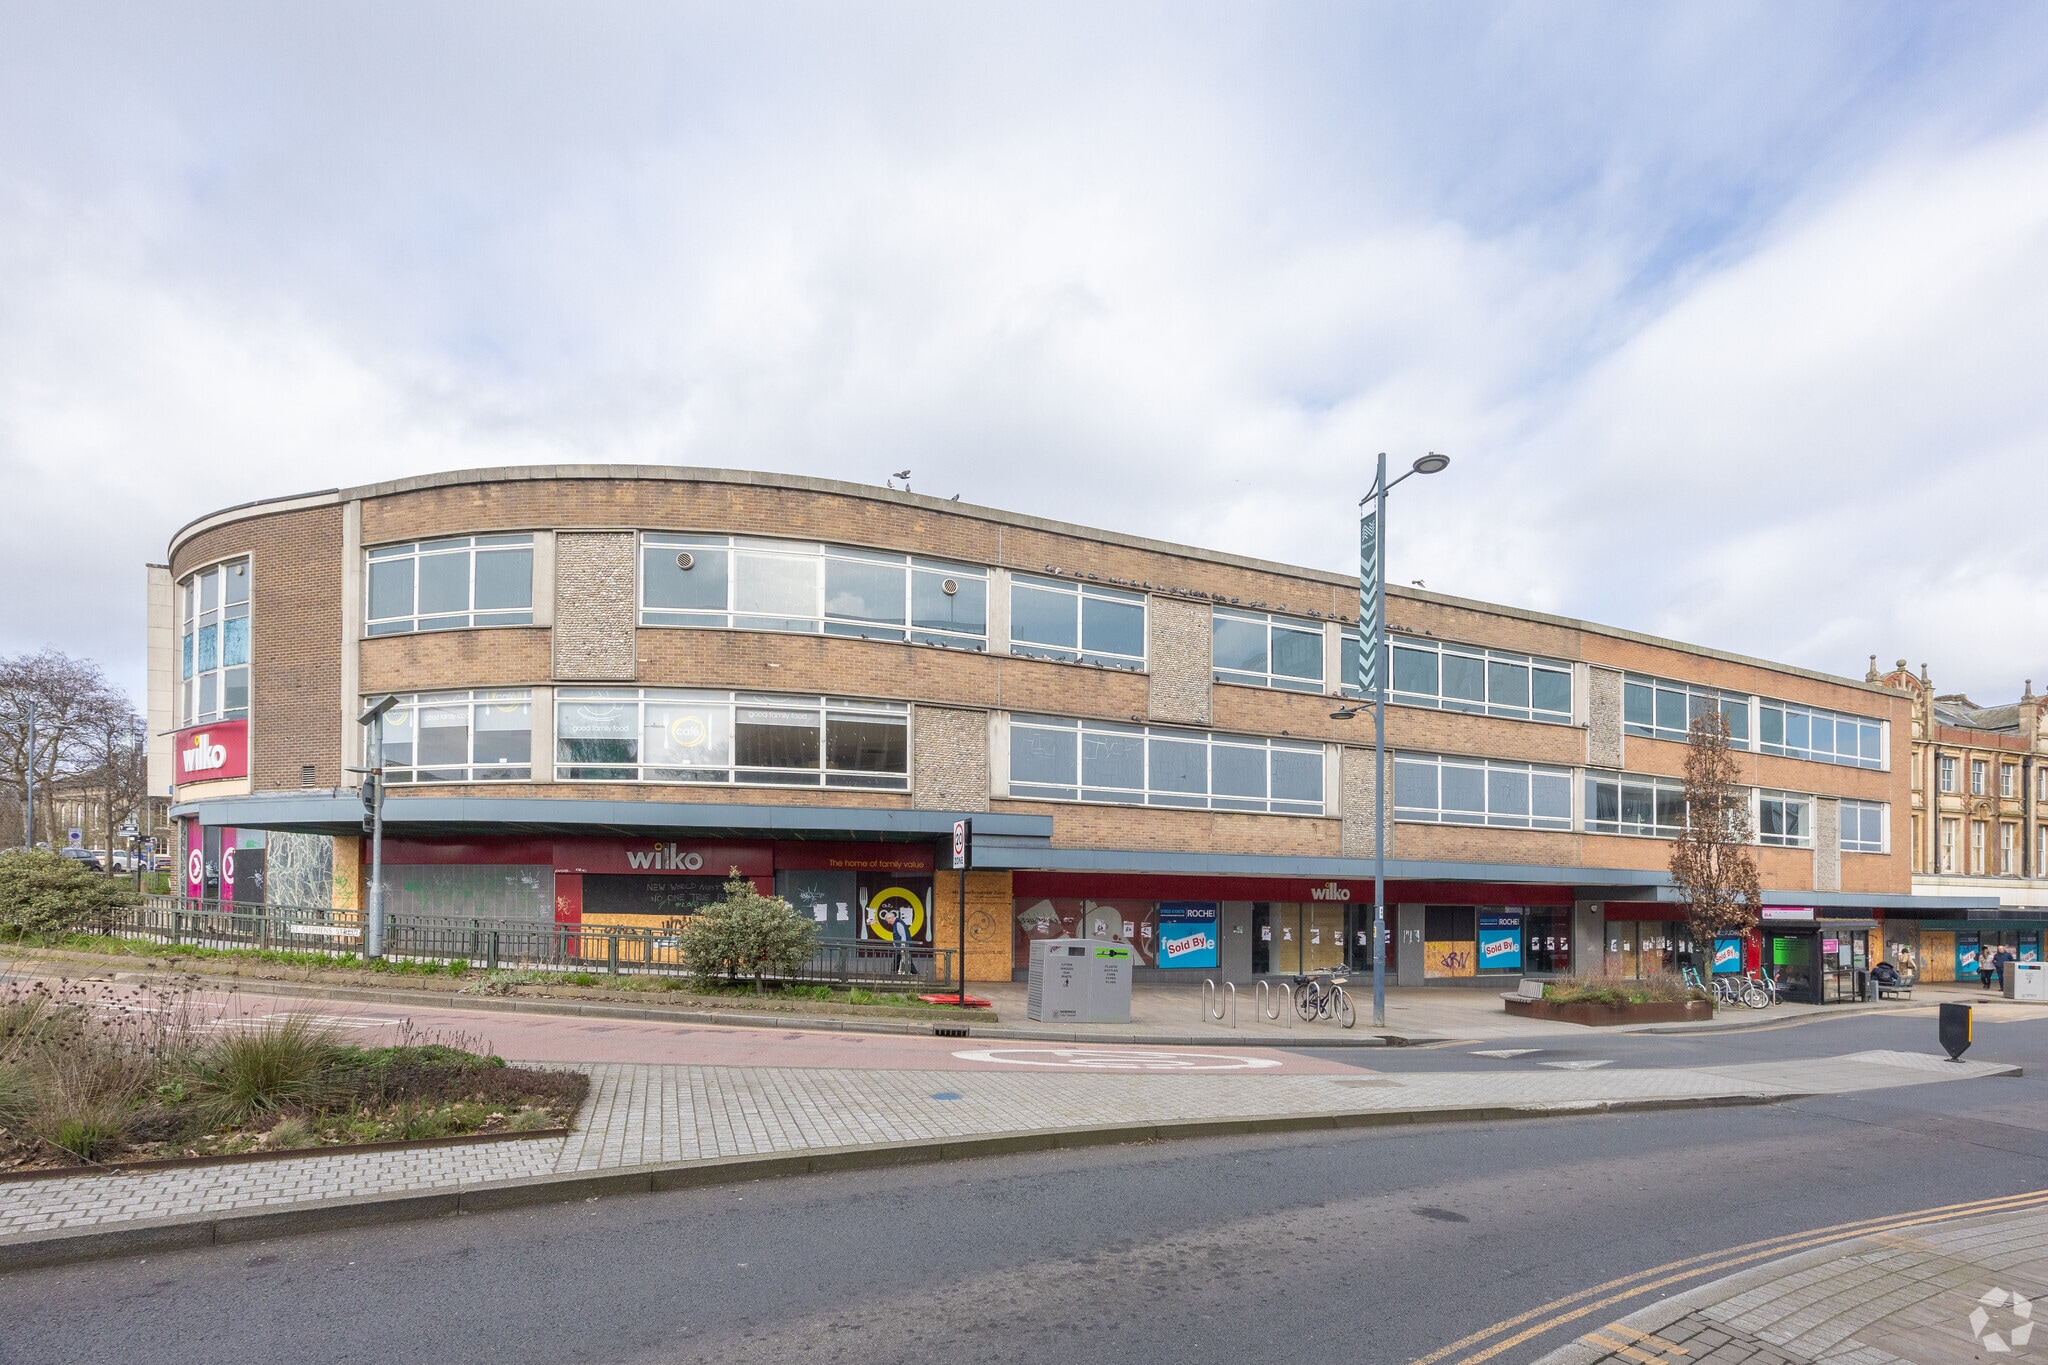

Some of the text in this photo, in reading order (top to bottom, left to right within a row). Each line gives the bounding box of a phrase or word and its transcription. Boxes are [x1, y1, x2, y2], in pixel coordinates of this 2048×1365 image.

[424, 713, 440, 722] good
[748, 711, 808, 721] good family food
[572, 725, 629, 733] good family food
[675, 726, 700, 737] café
[183, 733, 227, 773] wilko
[956, 832, 963, 846] 20
[626, 842, 704, 870] wilko
[954, 856, 964, 866] ZONE
[829, 859, 925, 869] The home of family value
[646, 883, 666, 892] NEW
[1310, 881, 1351, 901] wilko
[1168, 940, 1190, 954] Sold
[1192, 937, 1205, 948] By
[1486, 941, 1513, 955] Sold By
[1715, 949, 1734, 963] Sold By
